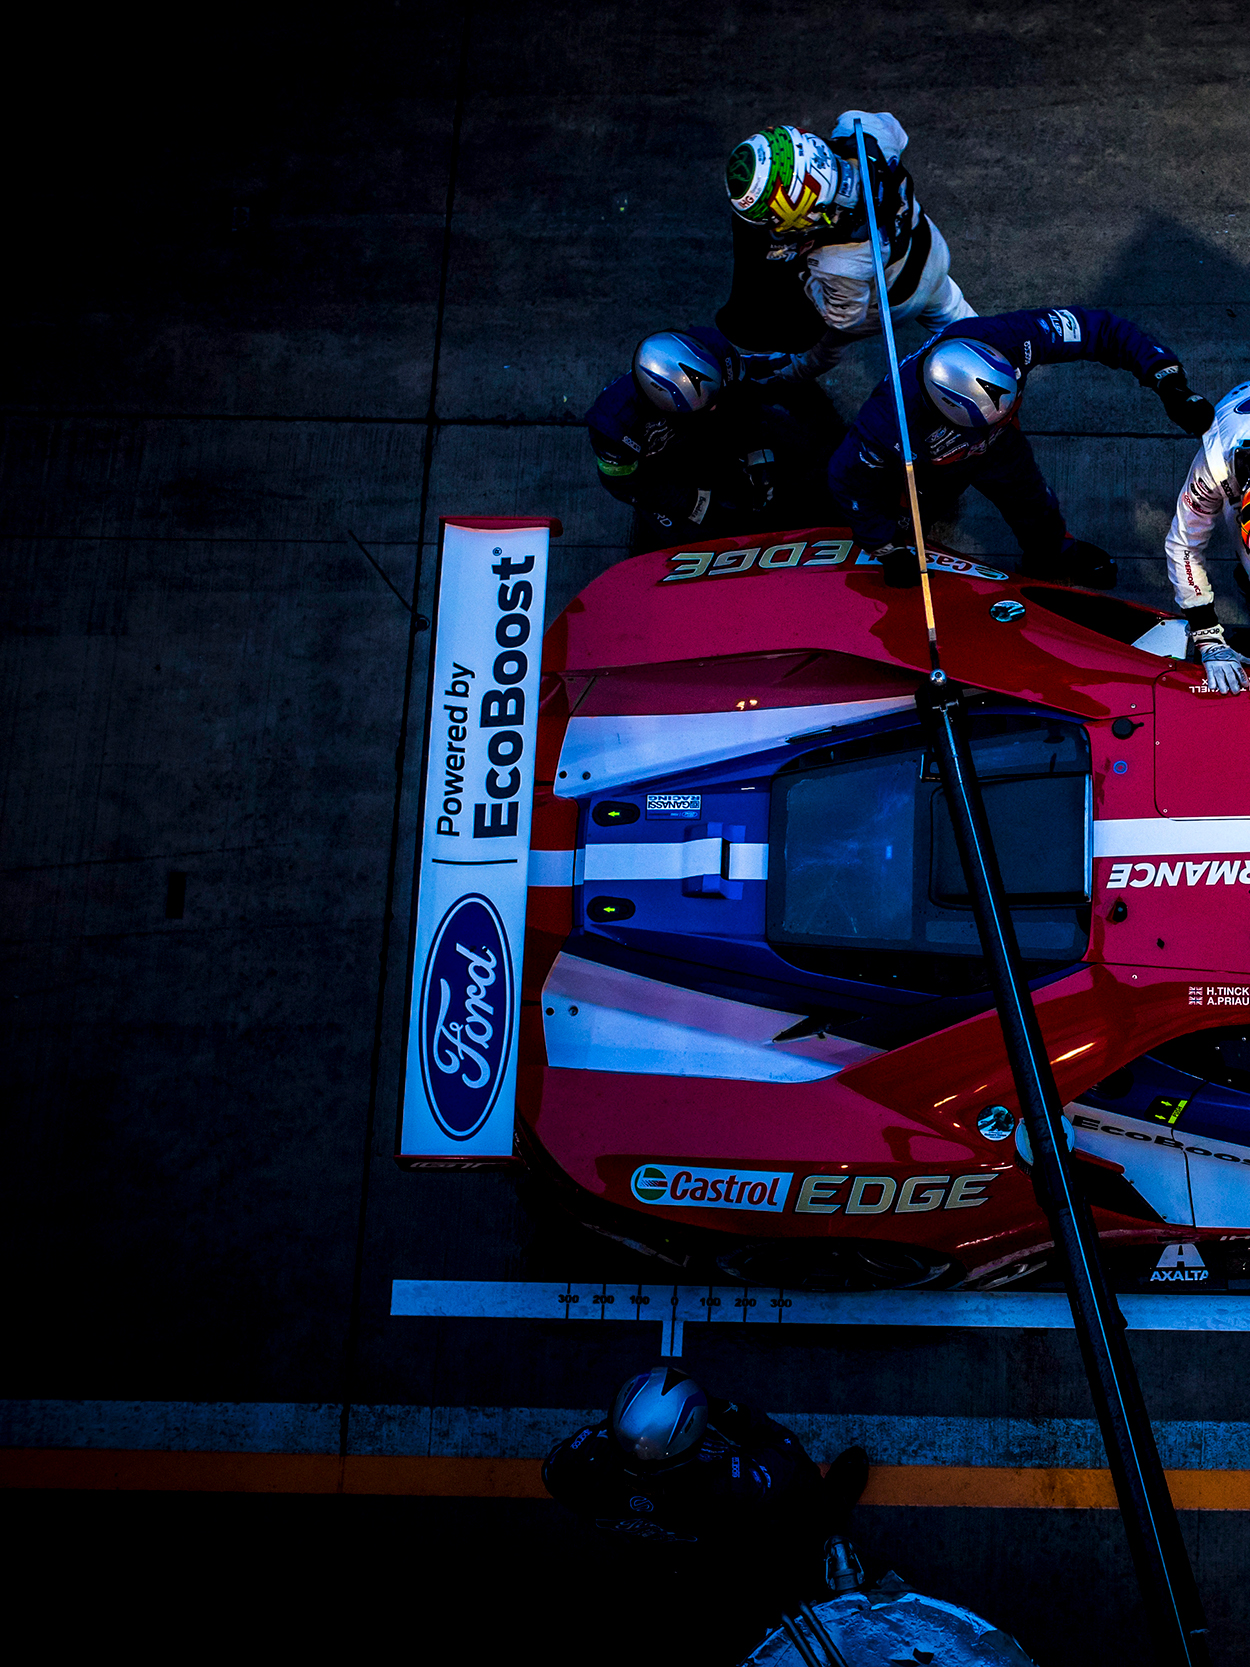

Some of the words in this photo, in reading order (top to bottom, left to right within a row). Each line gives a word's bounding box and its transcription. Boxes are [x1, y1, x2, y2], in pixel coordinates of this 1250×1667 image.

[662, 540, 854, 582] EDGE
[443, 662, 476, 698] by
[473, 555, 536, 838] EcoBoost
[436, 705, 469, 837] Powered
[648, 801, 690, 809] GANASSI
[433, 942, 498, 1089] Ford
[669, 1170, 781, 1206] Castrol
[794, 1173, 1000, 1215] EDGE
[1150, 1269, 1210, 1282] AXALTA
[558, 1294, 579, 1304] 300
[592, 1294, 615, 1304] 200
[629, 1296, 650, 1305] 100
[670, 1297, 679, 1306] 0
[700, 1297, 721, 1307] 100
[734, 1298, 757, 1307] 200
[770, 1298, 792, 1308] 300
